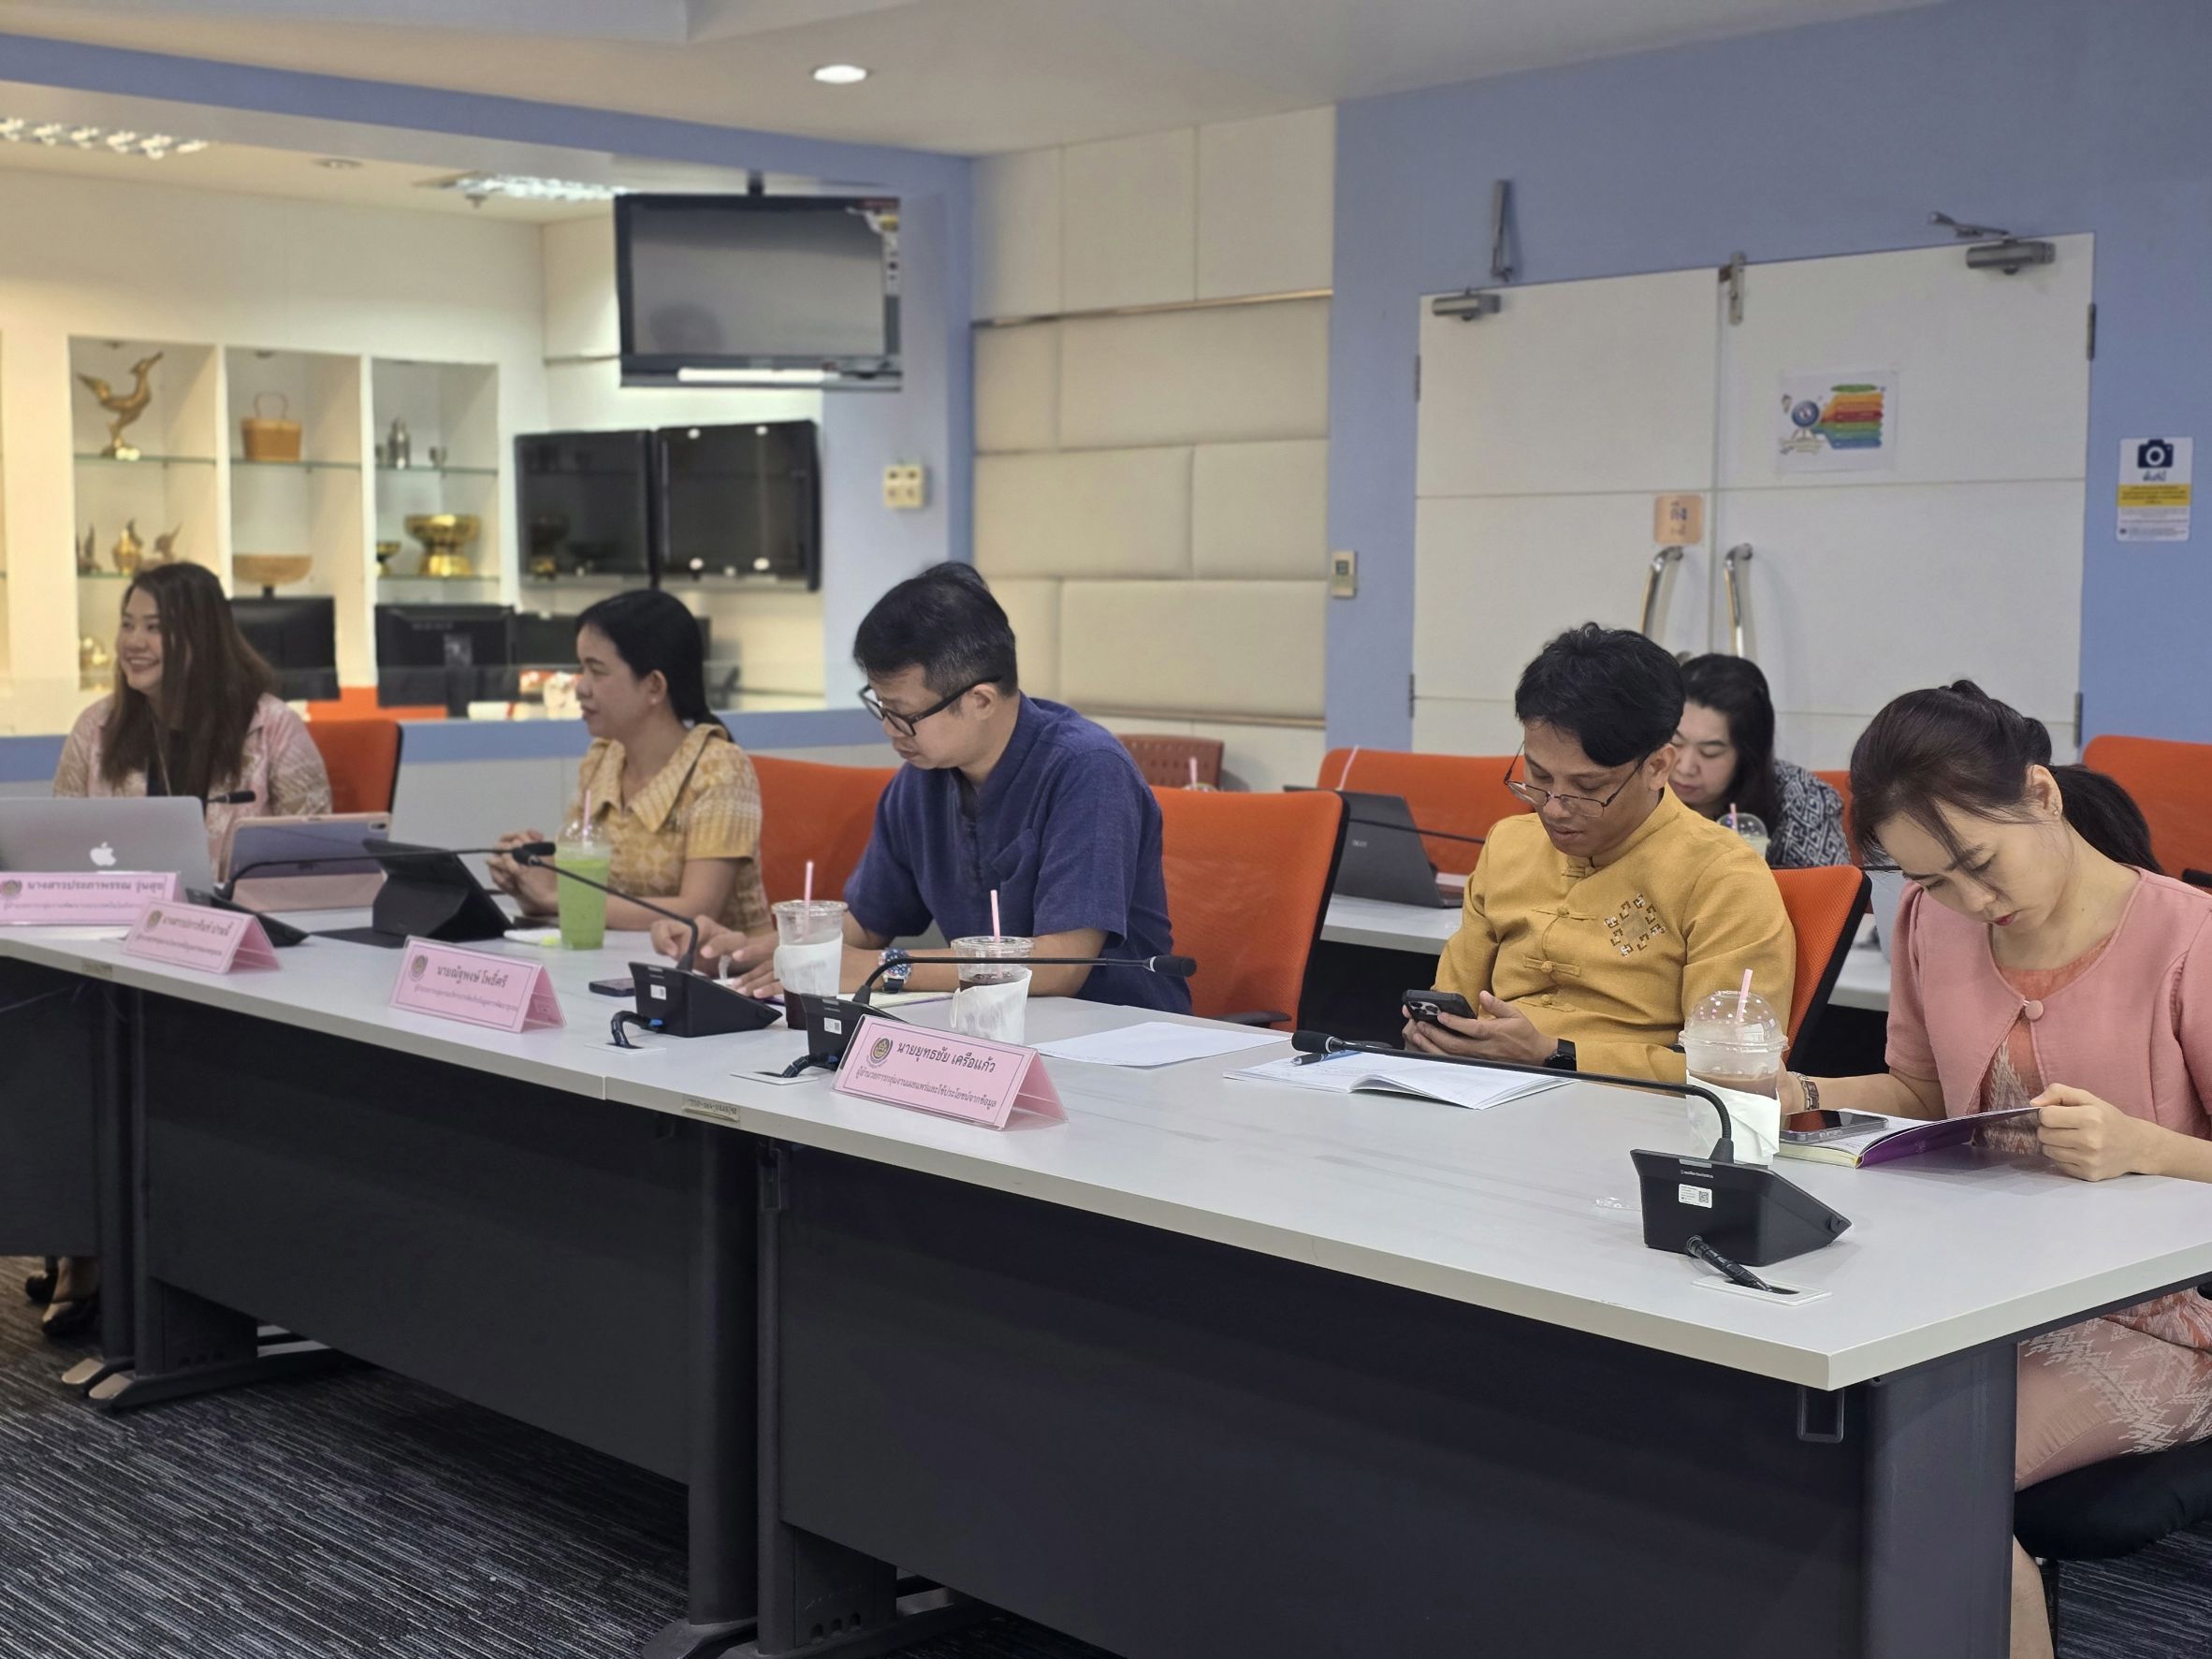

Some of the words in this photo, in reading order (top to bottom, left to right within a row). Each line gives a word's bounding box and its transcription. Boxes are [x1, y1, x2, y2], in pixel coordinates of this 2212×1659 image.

[896, 1041, 951, 1064] นายยุทธชัย
[951, 1052, 997, 1073] เครือแก้ว
